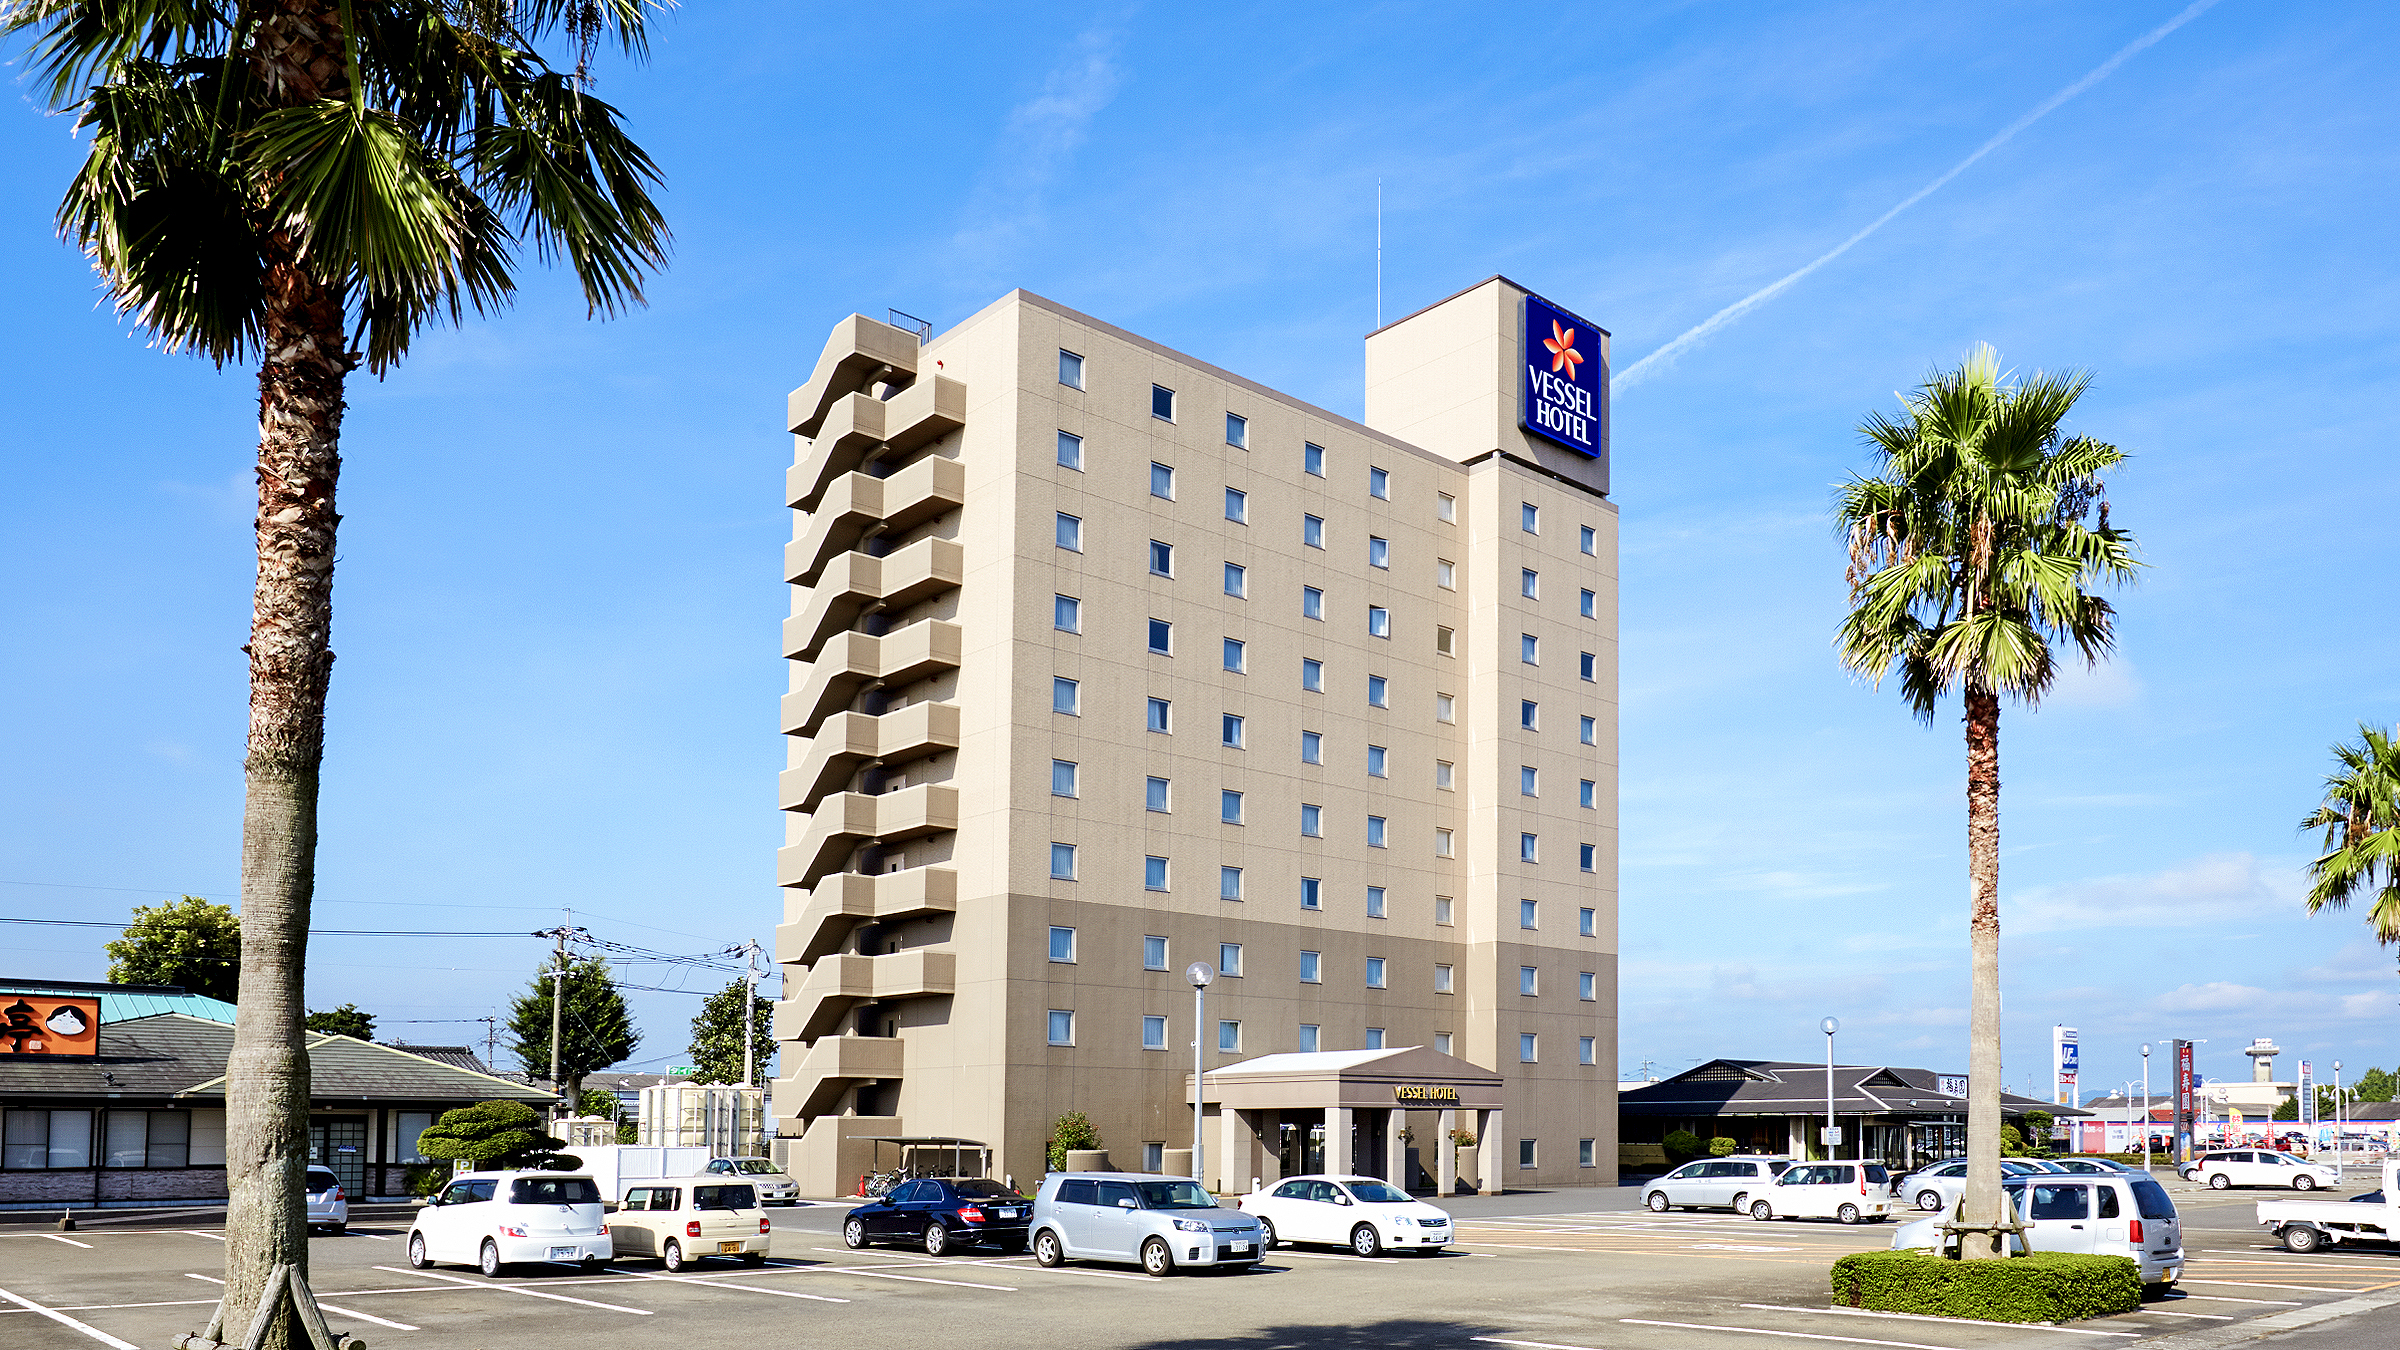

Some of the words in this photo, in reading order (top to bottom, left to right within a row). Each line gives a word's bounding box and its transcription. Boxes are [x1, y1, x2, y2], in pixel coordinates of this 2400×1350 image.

[1528, 364, 1597, 422] VESSEL
[1536, 398, 1592, 446] HOTEL
[1394, 1085, 1428, 1099] VESSEL
[1430, 1086, 1458, 1100] HOTEL
[460, 1161, 470, 1170] P
